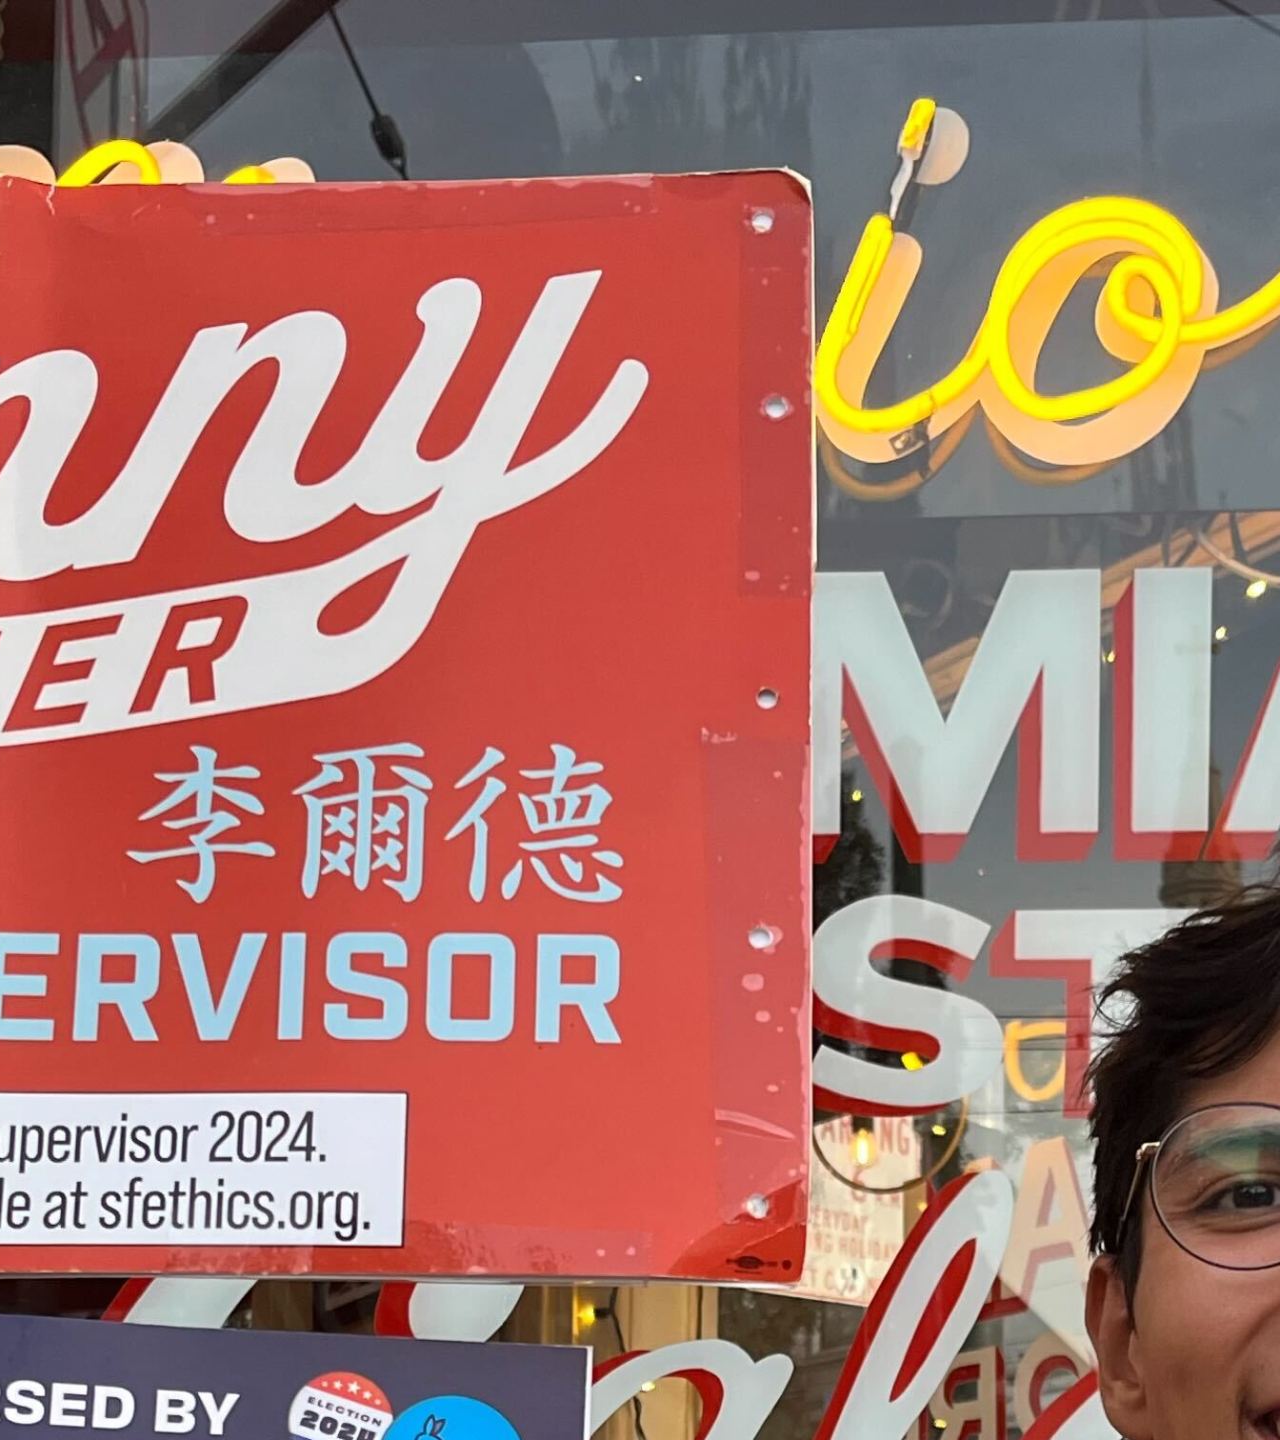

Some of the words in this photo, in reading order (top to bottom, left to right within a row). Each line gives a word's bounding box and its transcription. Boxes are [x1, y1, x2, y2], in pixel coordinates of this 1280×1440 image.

[127, 741, 625, 905] 李爾德
[208, 1110, 327, 1163] 2024.
[42, 1179, 89, 1229] at
[98, 1177, 371, 1242] sfethics.org.
[154, 1388, 240, 1436] BY
[307, 1396, 382, 1427] ELECTION
